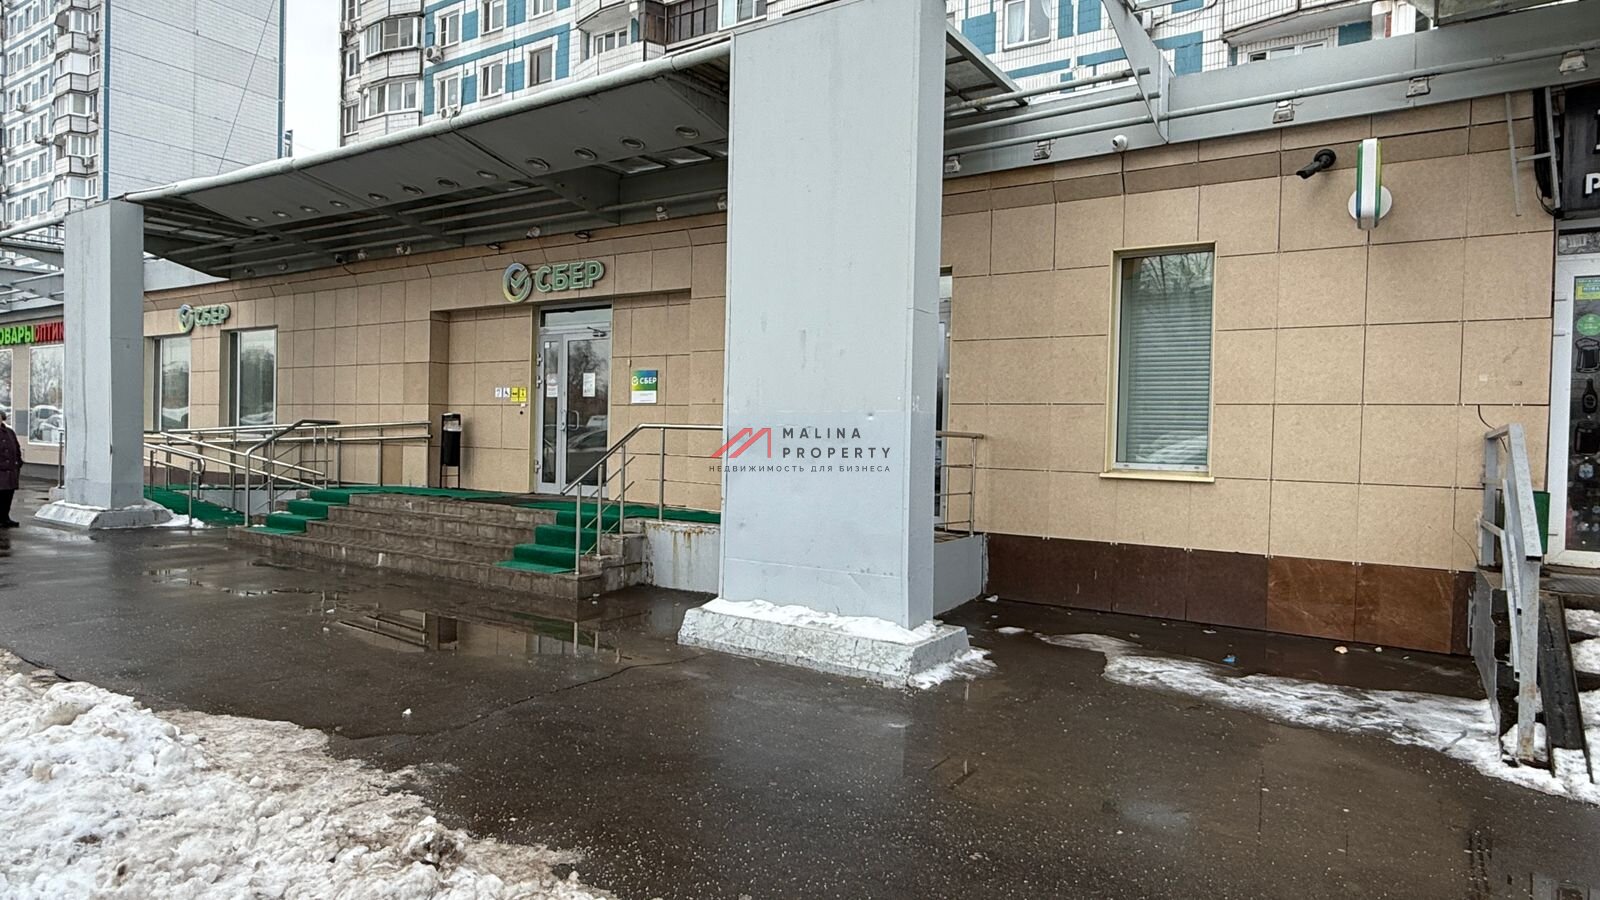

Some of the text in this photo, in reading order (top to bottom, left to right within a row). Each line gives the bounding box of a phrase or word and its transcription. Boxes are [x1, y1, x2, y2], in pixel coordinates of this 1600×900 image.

[535, 261, 604, 293] СБЕР
[194, 304, 230, 326] СБЕР
[639, 376, 657, 385] СБЕР
